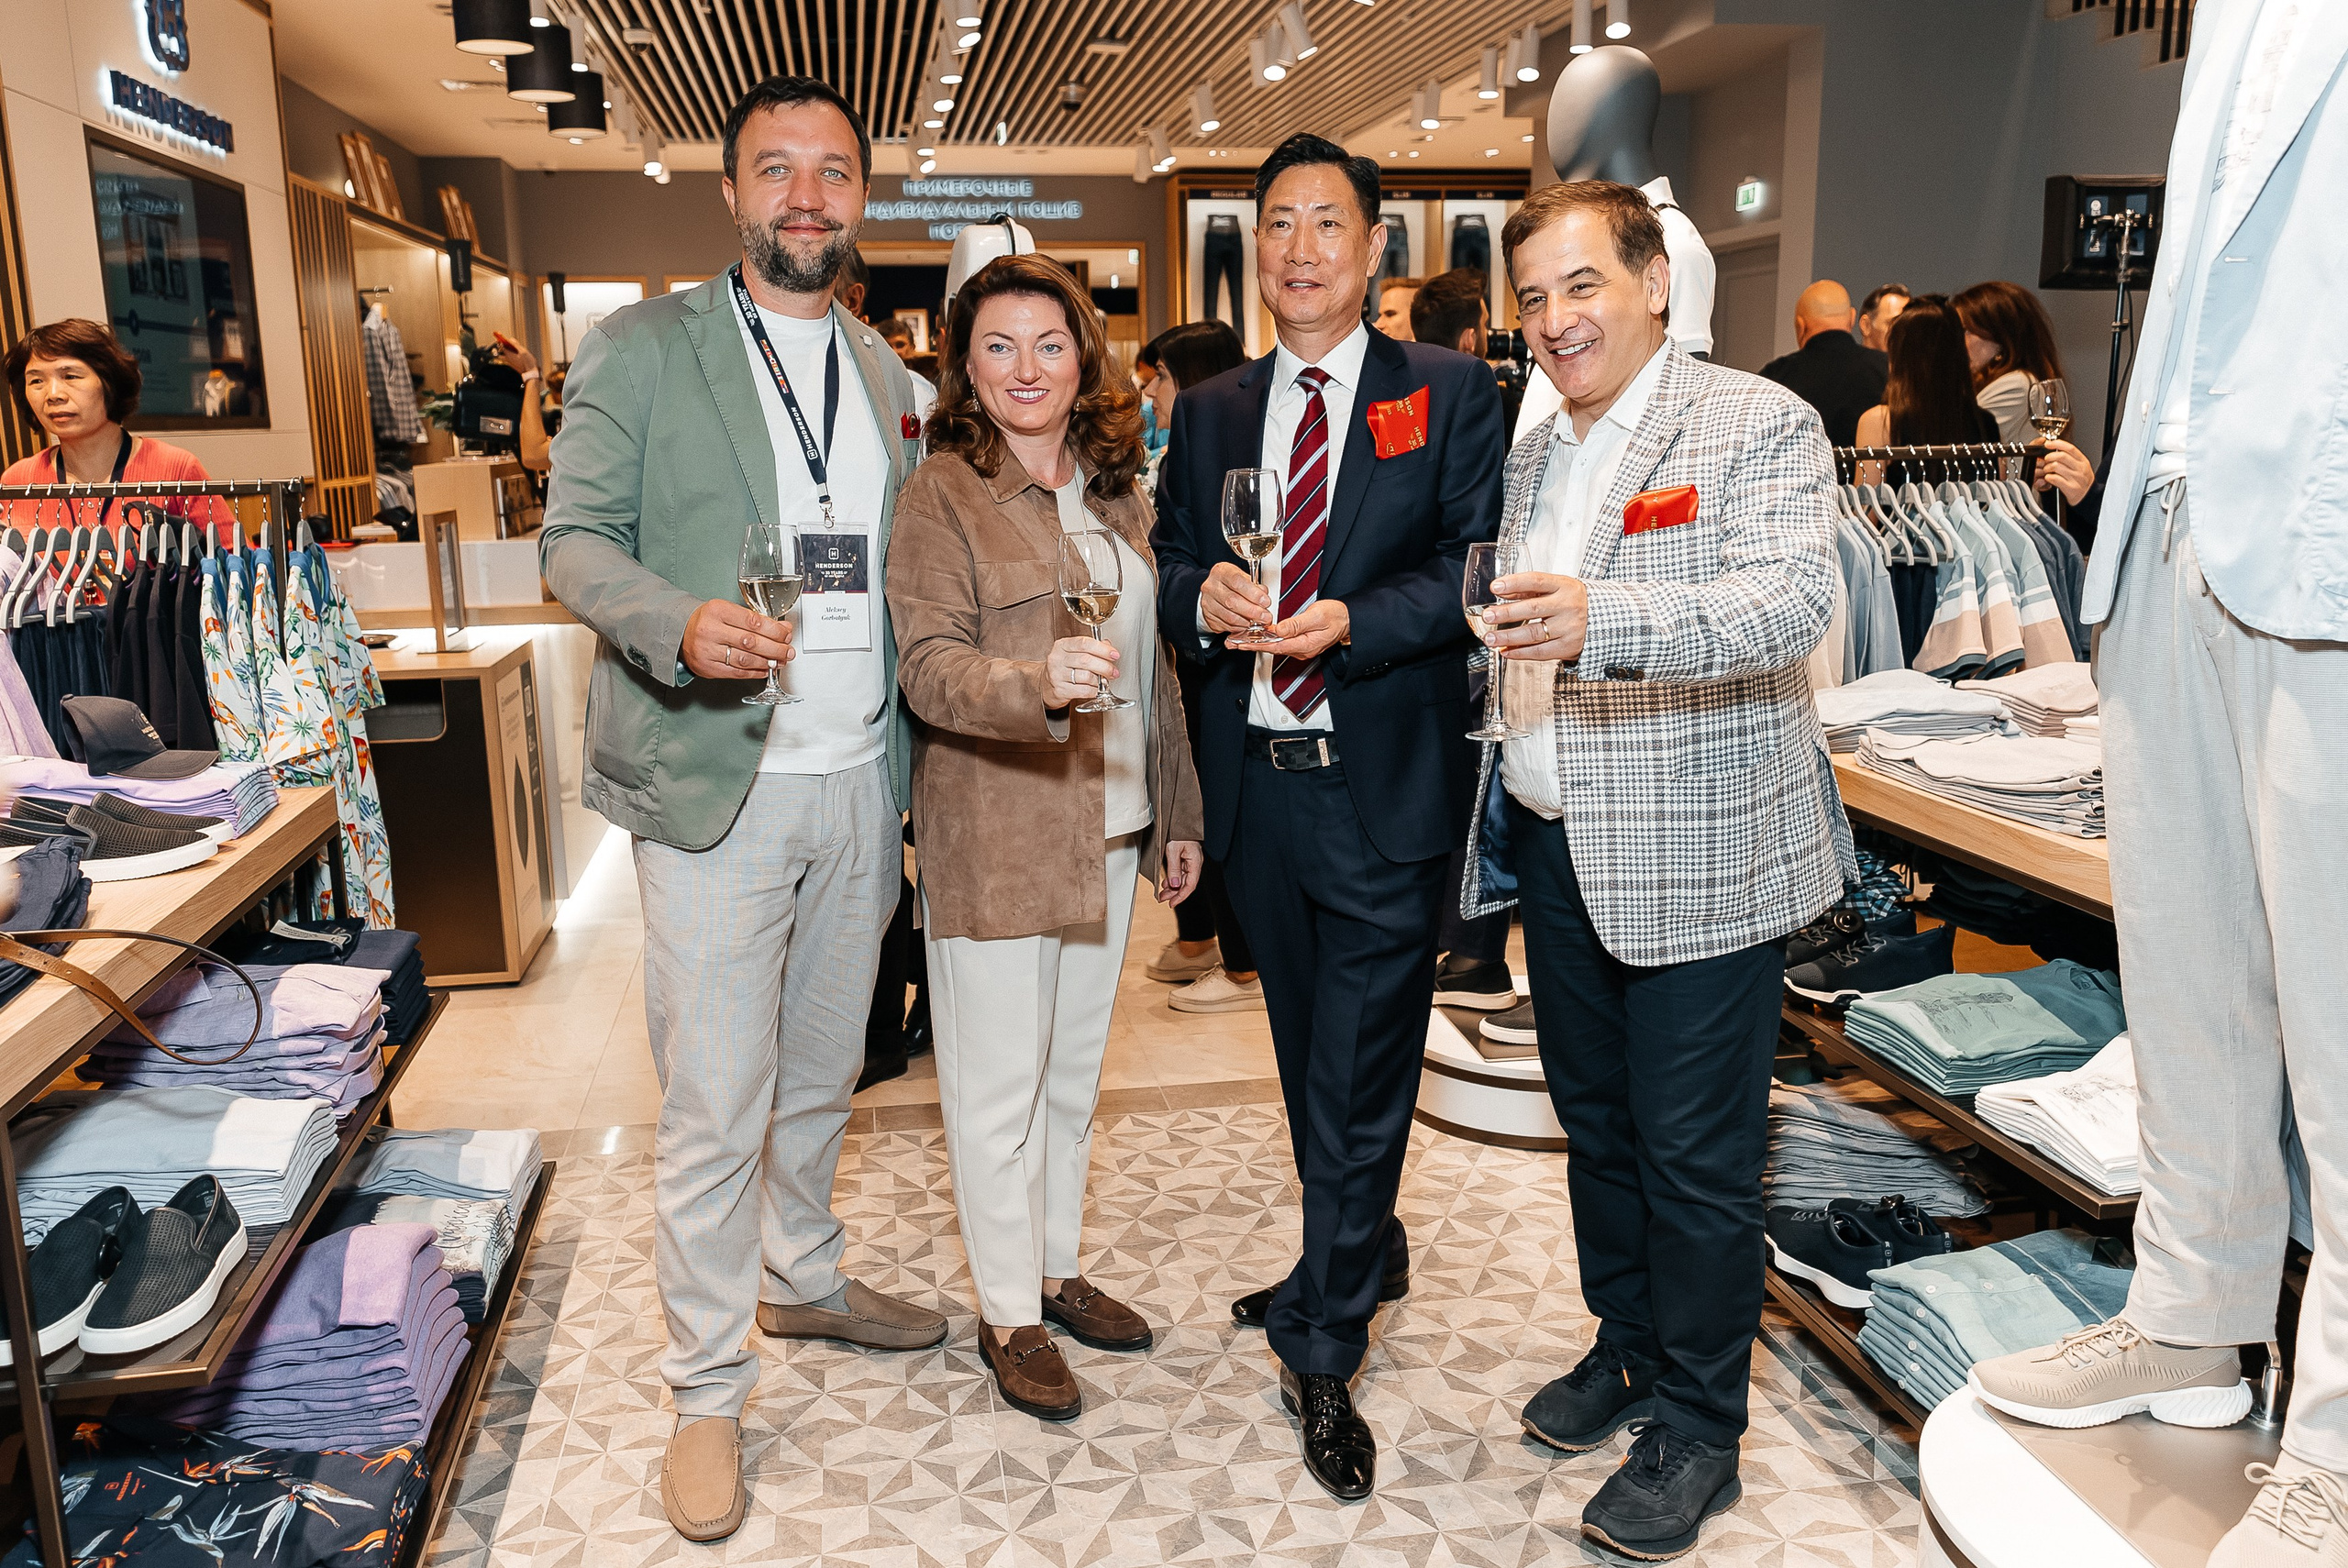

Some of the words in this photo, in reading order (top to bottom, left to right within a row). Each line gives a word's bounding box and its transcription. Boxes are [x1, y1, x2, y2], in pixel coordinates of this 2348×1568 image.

[109, 70, 234, 154] HENDERSON
[903, 179, 1034, 197] ПРИМЕРОЧНЫЕ
[1018, 200, 1082, 219] ПОШИВ
[737, 293, 748, 312] YEARS
[791, 406, 814, 450] HENDERSON
